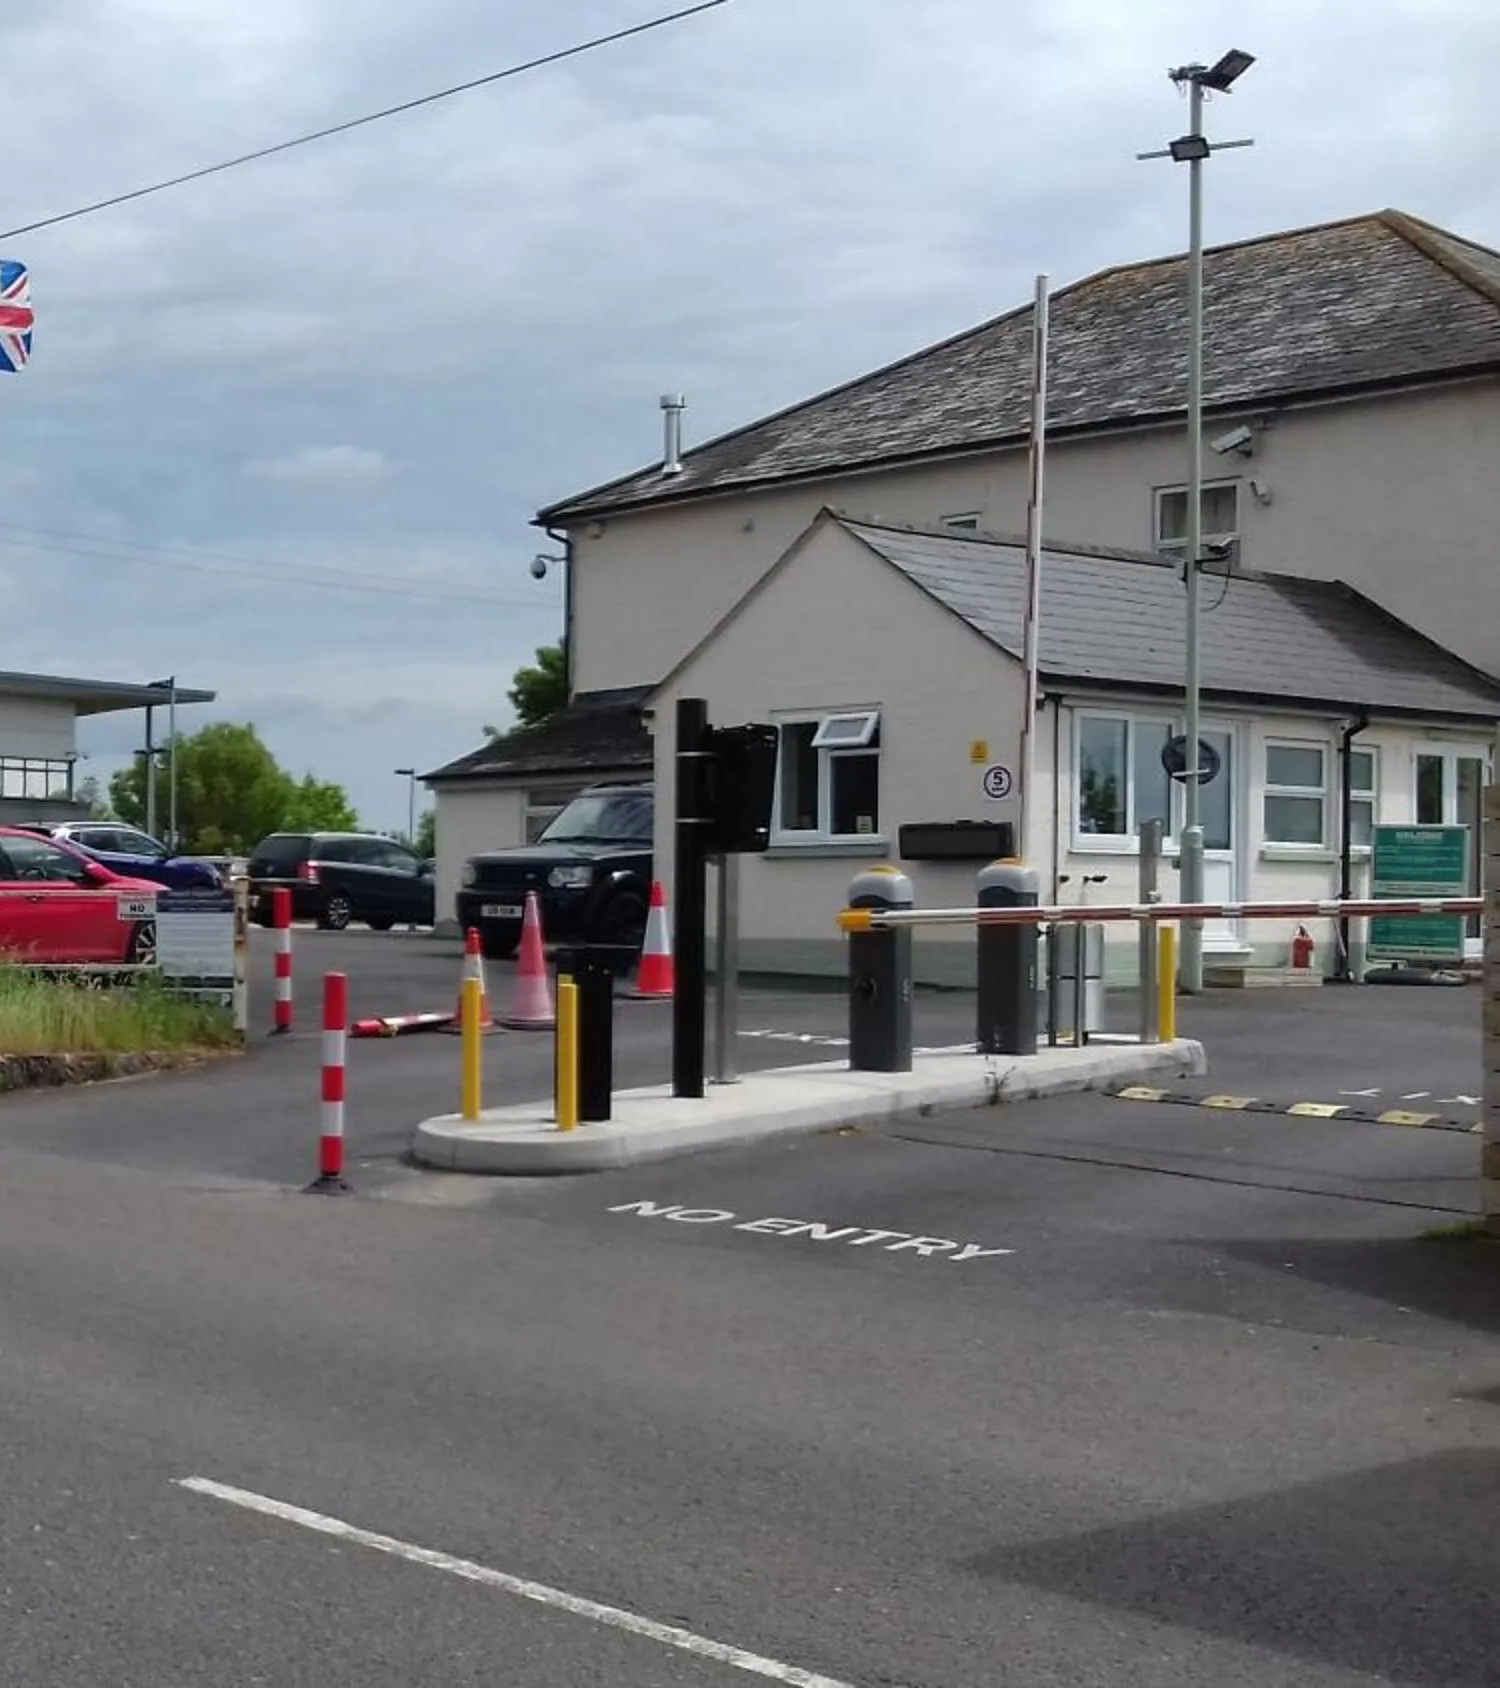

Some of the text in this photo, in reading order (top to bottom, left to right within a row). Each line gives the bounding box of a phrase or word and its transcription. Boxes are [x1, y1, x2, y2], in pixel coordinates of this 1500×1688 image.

[993, 771, 1003, 785] 5
[606, 1201, 1017, 1260] NO ENTRY
